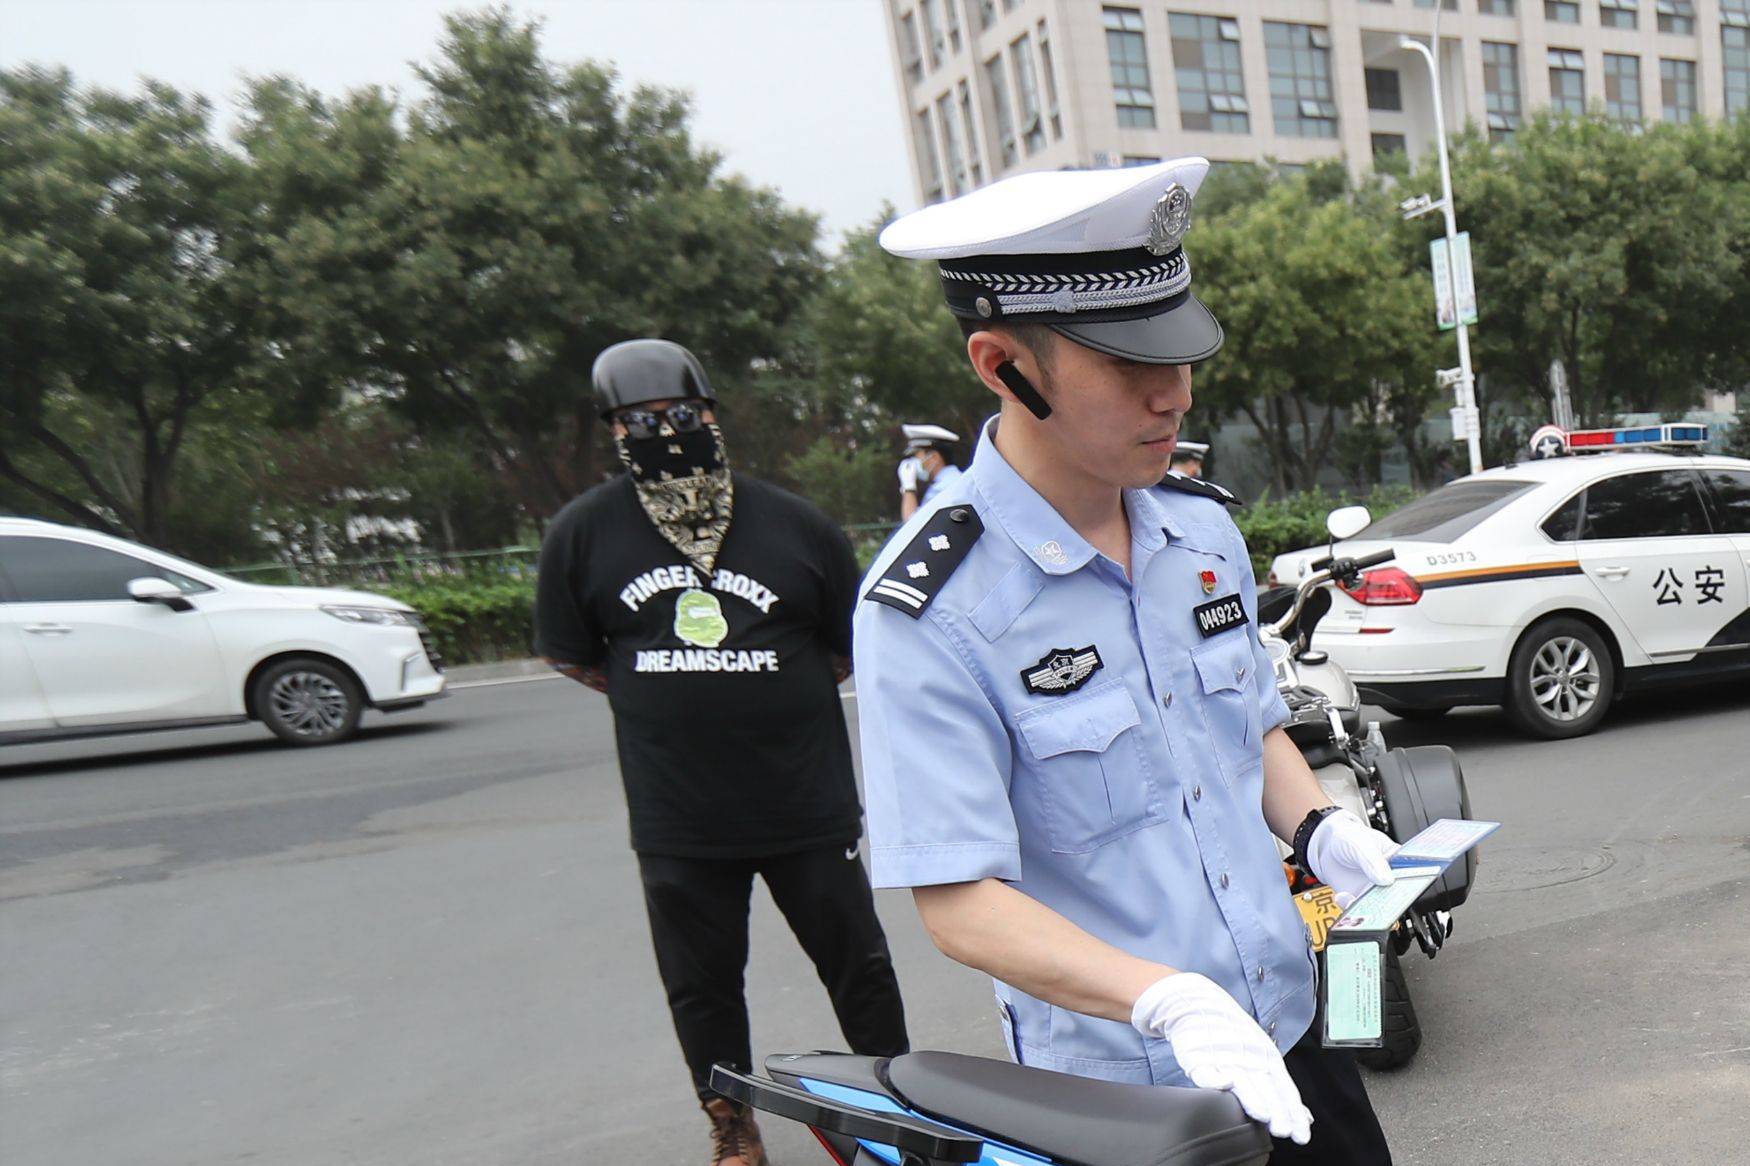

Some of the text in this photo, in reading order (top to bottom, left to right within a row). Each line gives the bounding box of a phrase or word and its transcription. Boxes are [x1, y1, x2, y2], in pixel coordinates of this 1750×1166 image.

[1426, 551, 1477, 566] D3573
[1652, 564, 1726, 607] 公安
[1199, 601, 1243, 631] 044923
[634, 650, 780, 673] DREAMSCAPE
